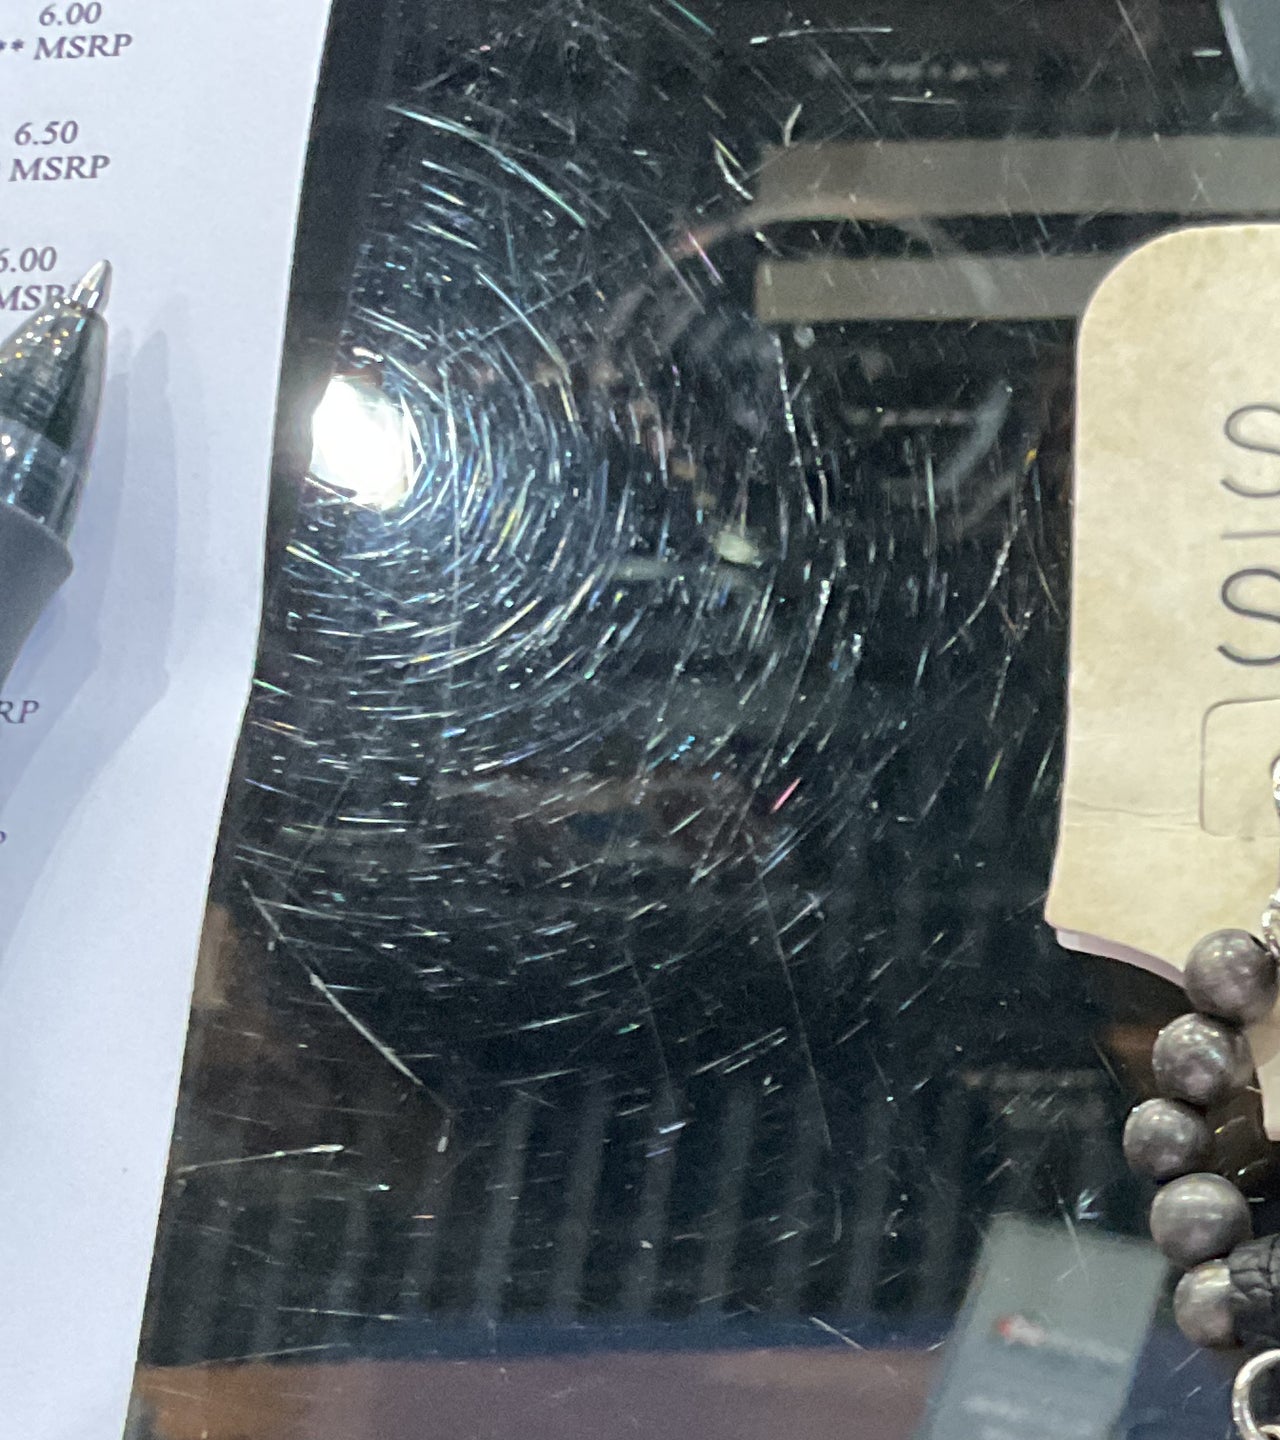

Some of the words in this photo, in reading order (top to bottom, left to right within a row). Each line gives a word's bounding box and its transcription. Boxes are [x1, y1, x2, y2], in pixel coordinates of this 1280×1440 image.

[39, 2, 102, 26] 6.00
[34, 34, 133, 60] MSRP
[15, 121, 78, 146] 6.50
[9, 155, 111, 182] MSRP
